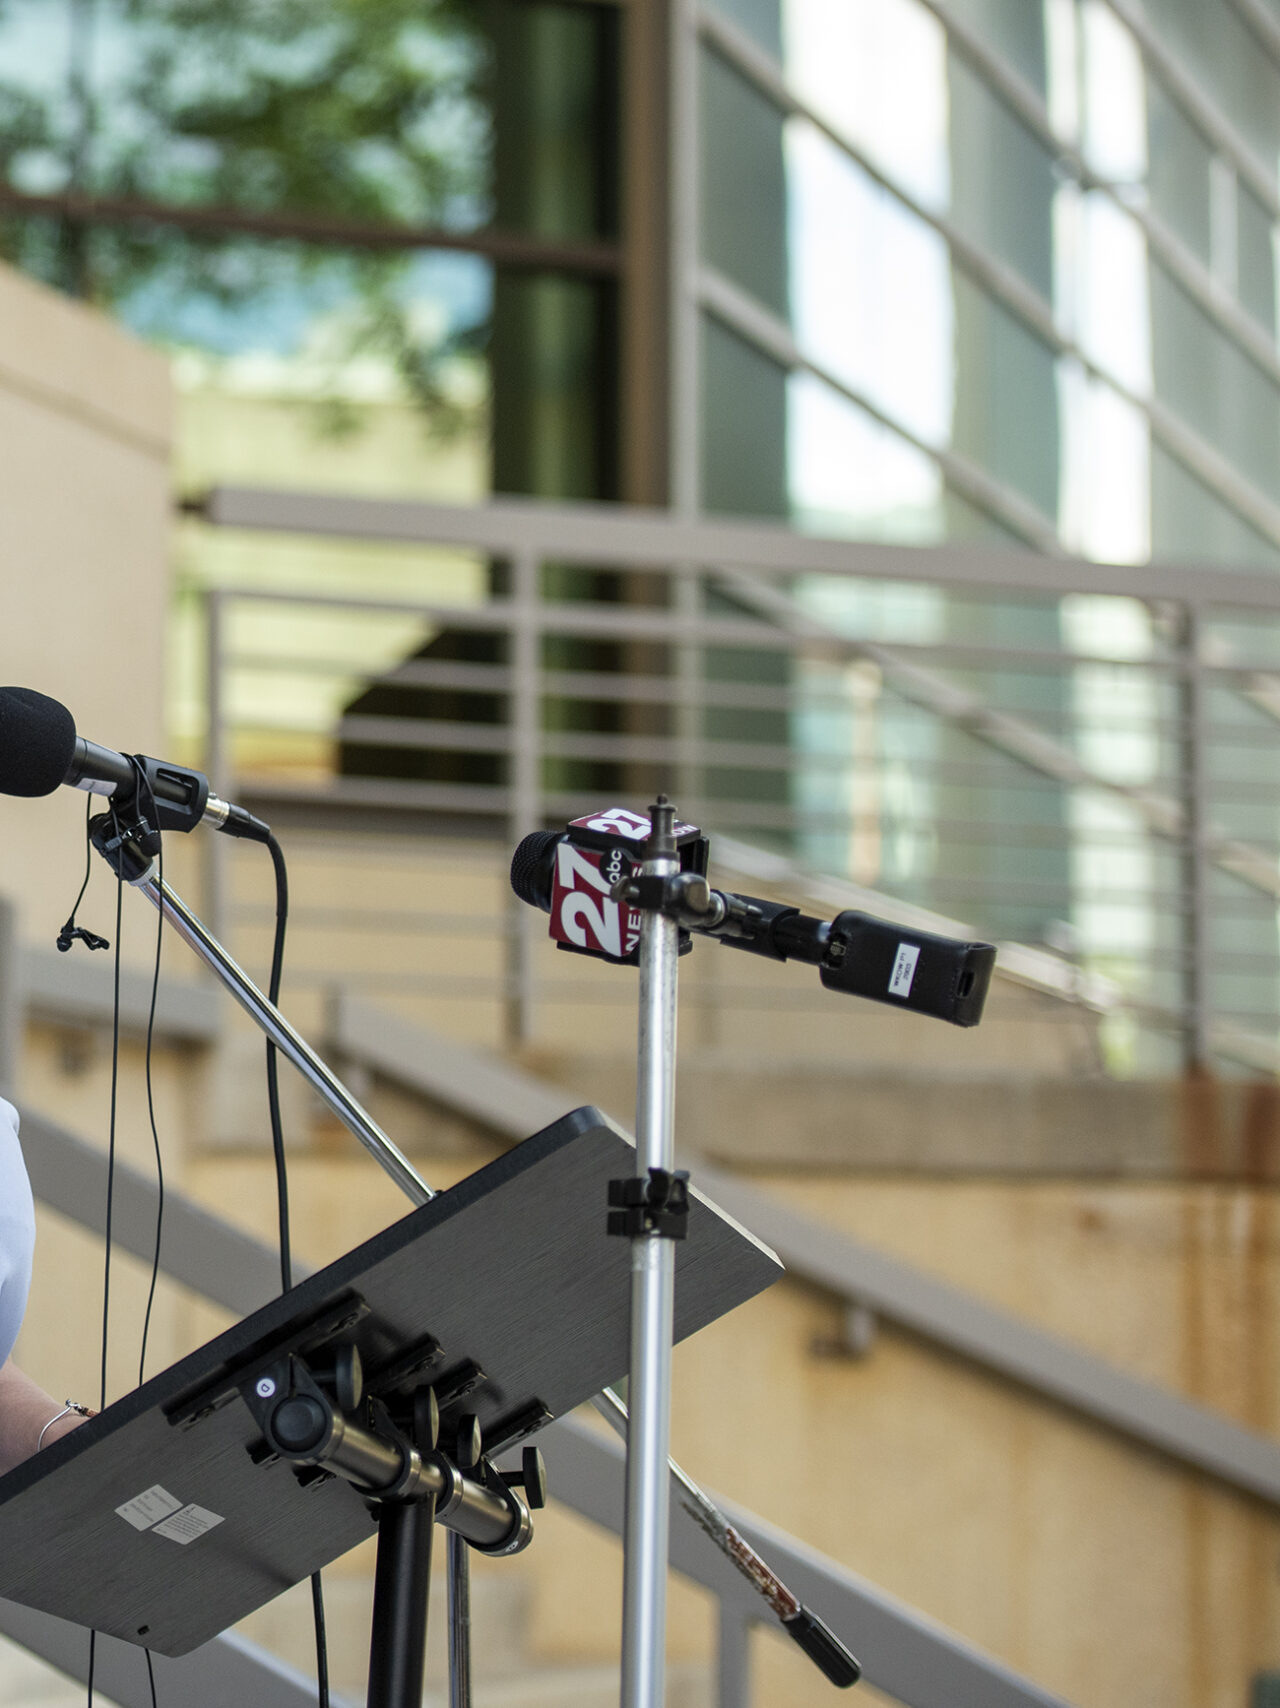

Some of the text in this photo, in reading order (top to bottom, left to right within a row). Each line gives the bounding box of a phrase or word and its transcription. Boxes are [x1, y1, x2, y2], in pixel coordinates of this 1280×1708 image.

[587, 808, 652, 840] 27
[606, 850, 622, 883] abc
[557, 842, 622, 957] 27
[625, 866, 643, 952] NES
